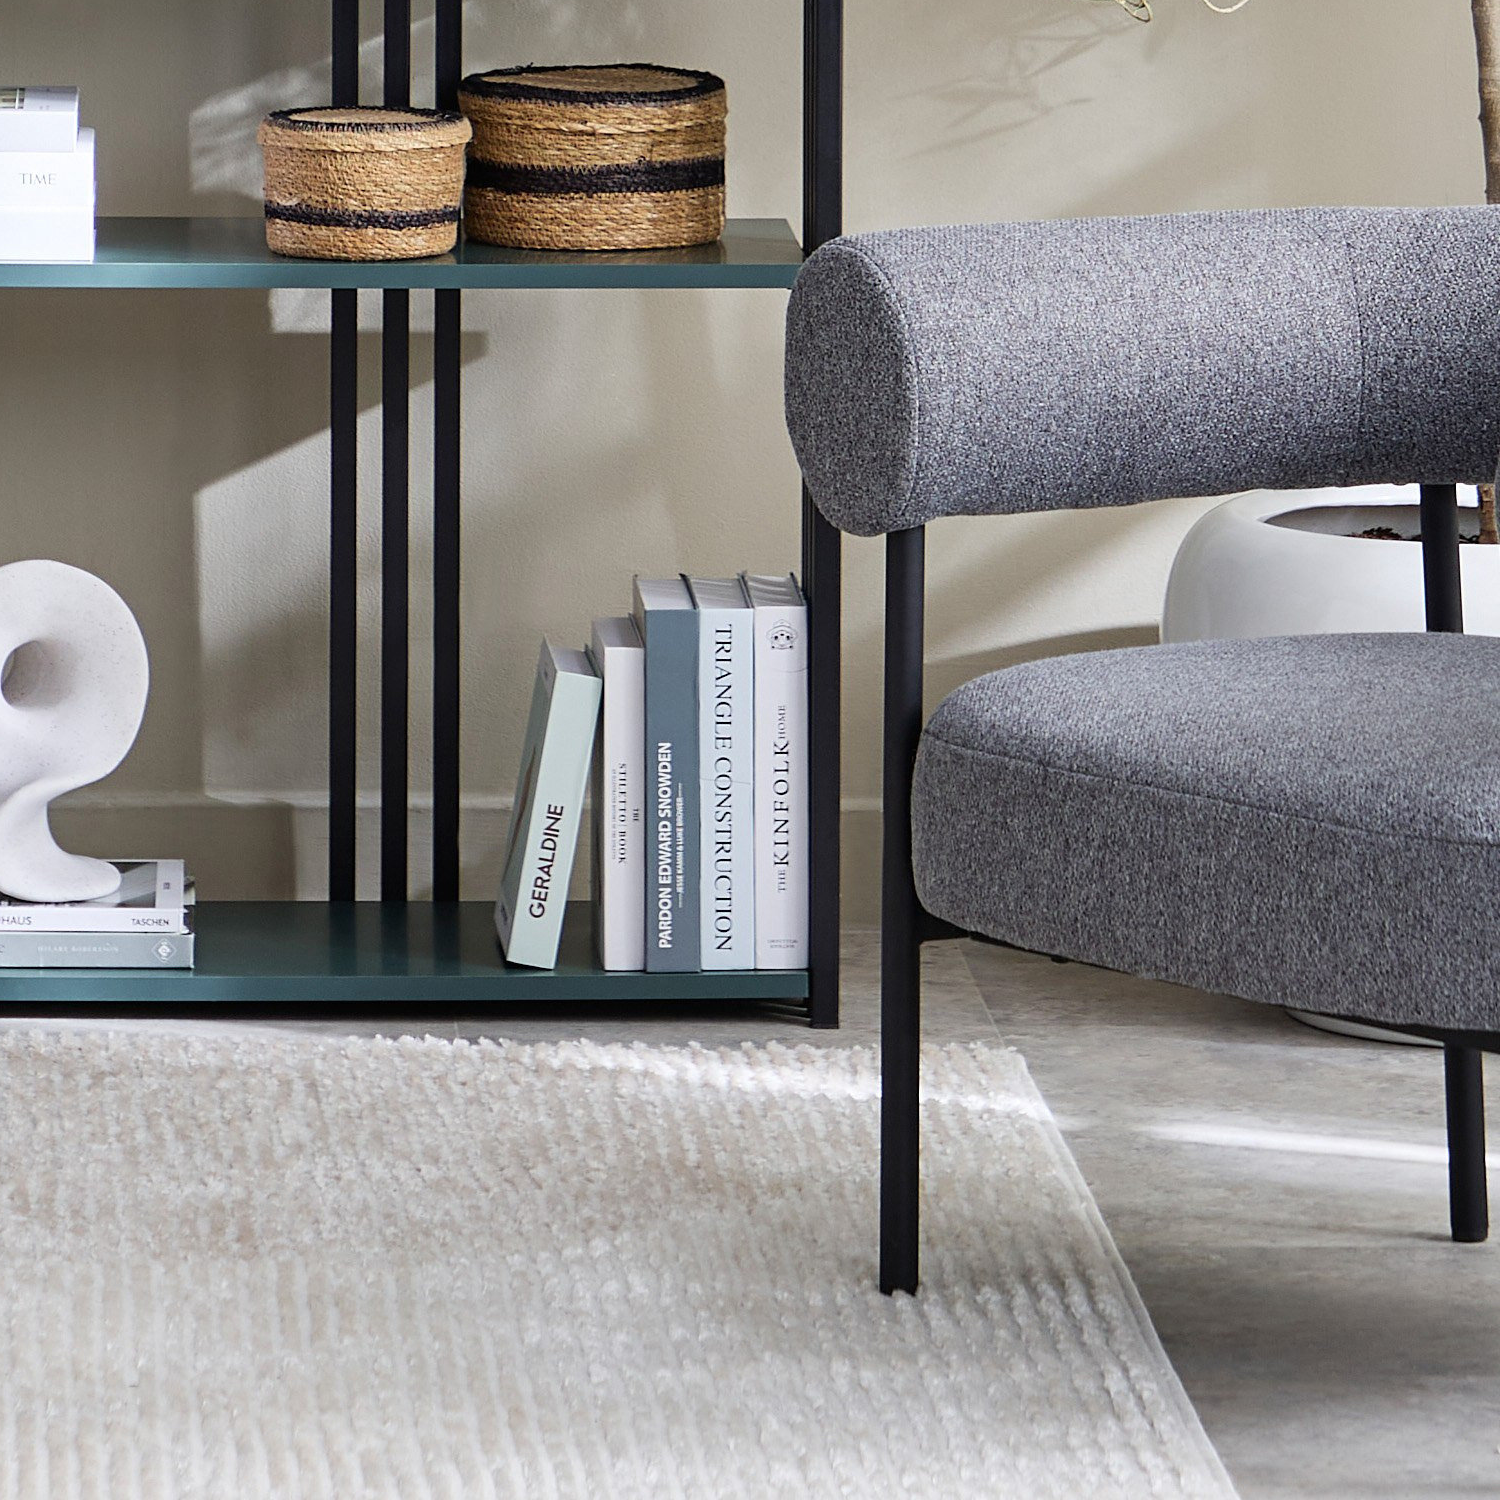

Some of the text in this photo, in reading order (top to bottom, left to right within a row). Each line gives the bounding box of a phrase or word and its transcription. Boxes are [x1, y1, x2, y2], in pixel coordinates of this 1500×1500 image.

[19, 172, 57, 185] TIME
[618, 763, 627, 865] STILETTO BOOK
[713, 623, 733, 951] TRIANGLE CONSTRUCTION
[773, 705, 790, 892] THE KINFOLK HOME
[529, 804, 564, 919] GERALDINE
[657, 742, 673, 949] PARDON EDWARD SNOWDEN
[131, 918, 171, 927] TASCHEN
